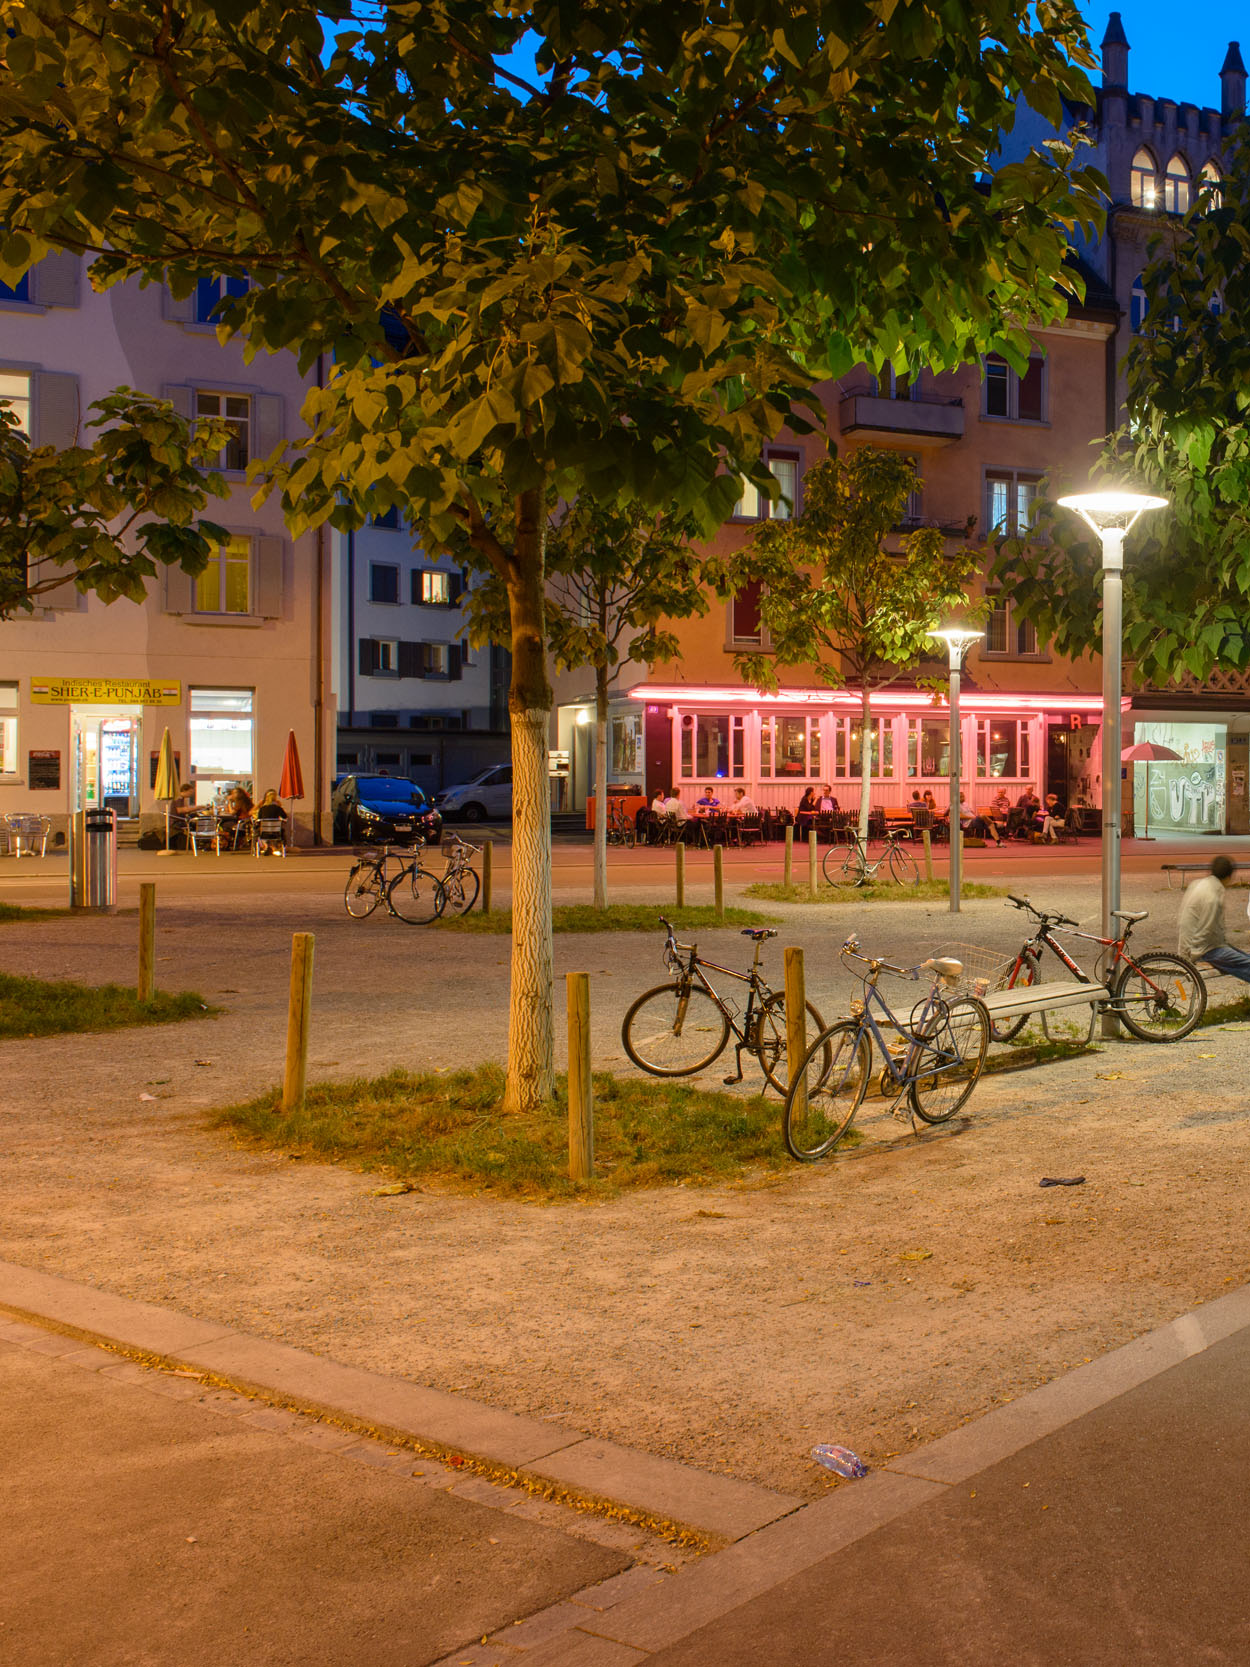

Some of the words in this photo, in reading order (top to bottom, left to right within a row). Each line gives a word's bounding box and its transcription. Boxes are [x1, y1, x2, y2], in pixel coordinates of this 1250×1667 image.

[62, 679, 103, 687] Indisches
[104, 680, 151, 688] Restaurant
[50, 687, 162, 699] SHER-E-PUNJAB
[1071, 714, 1082, 729] R
